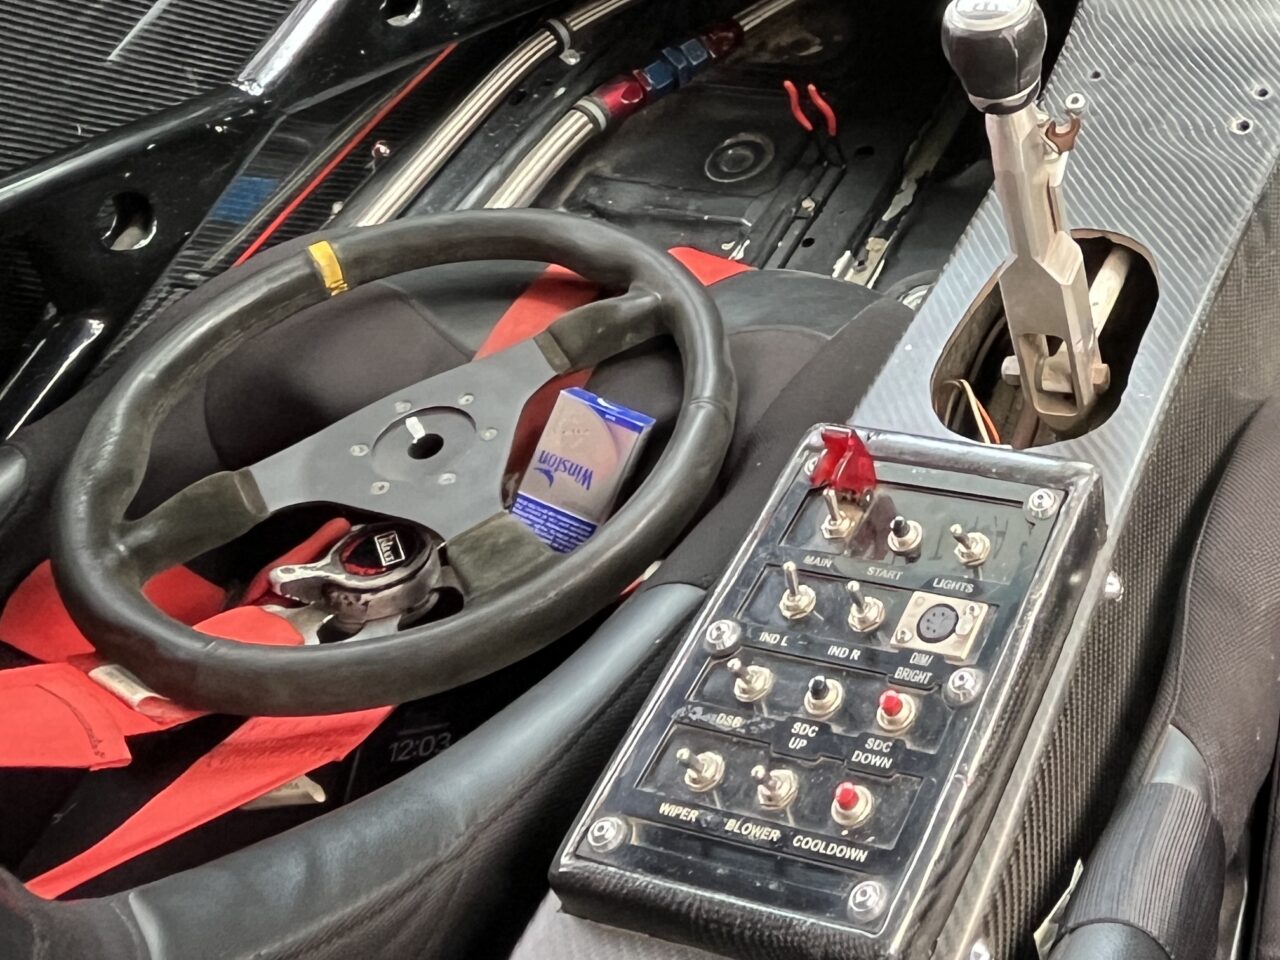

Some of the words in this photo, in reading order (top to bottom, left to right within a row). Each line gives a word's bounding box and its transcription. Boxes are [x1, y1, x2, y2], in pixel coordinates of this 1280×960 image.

[537, 450, 594, 491] Winston
[802, 555, 833, 568] MAIN
[866, 567, 904, 581] START
[932, 577, 975, 594] LIGHTS
[759, 631, 780, 645] IND
[780, 635, 788, 647] L
[827, 645, 850, 659] IND
[849, 649, 861, 661] R
[909, 652, 934, 667] DIM/
[893, 666, 933, 685] BRIGHT
[791, 722, 819, 738] SDC
[788, 736, 808, 750] UP
[864, 737, 894, 753] SDC
[851, 752, 893, 770] DOWN
[658, 802, 699, 822] WIPER
[724, 818, 781, 843] BLOWER
[792, 834, 869, 863] COOLDOWN
